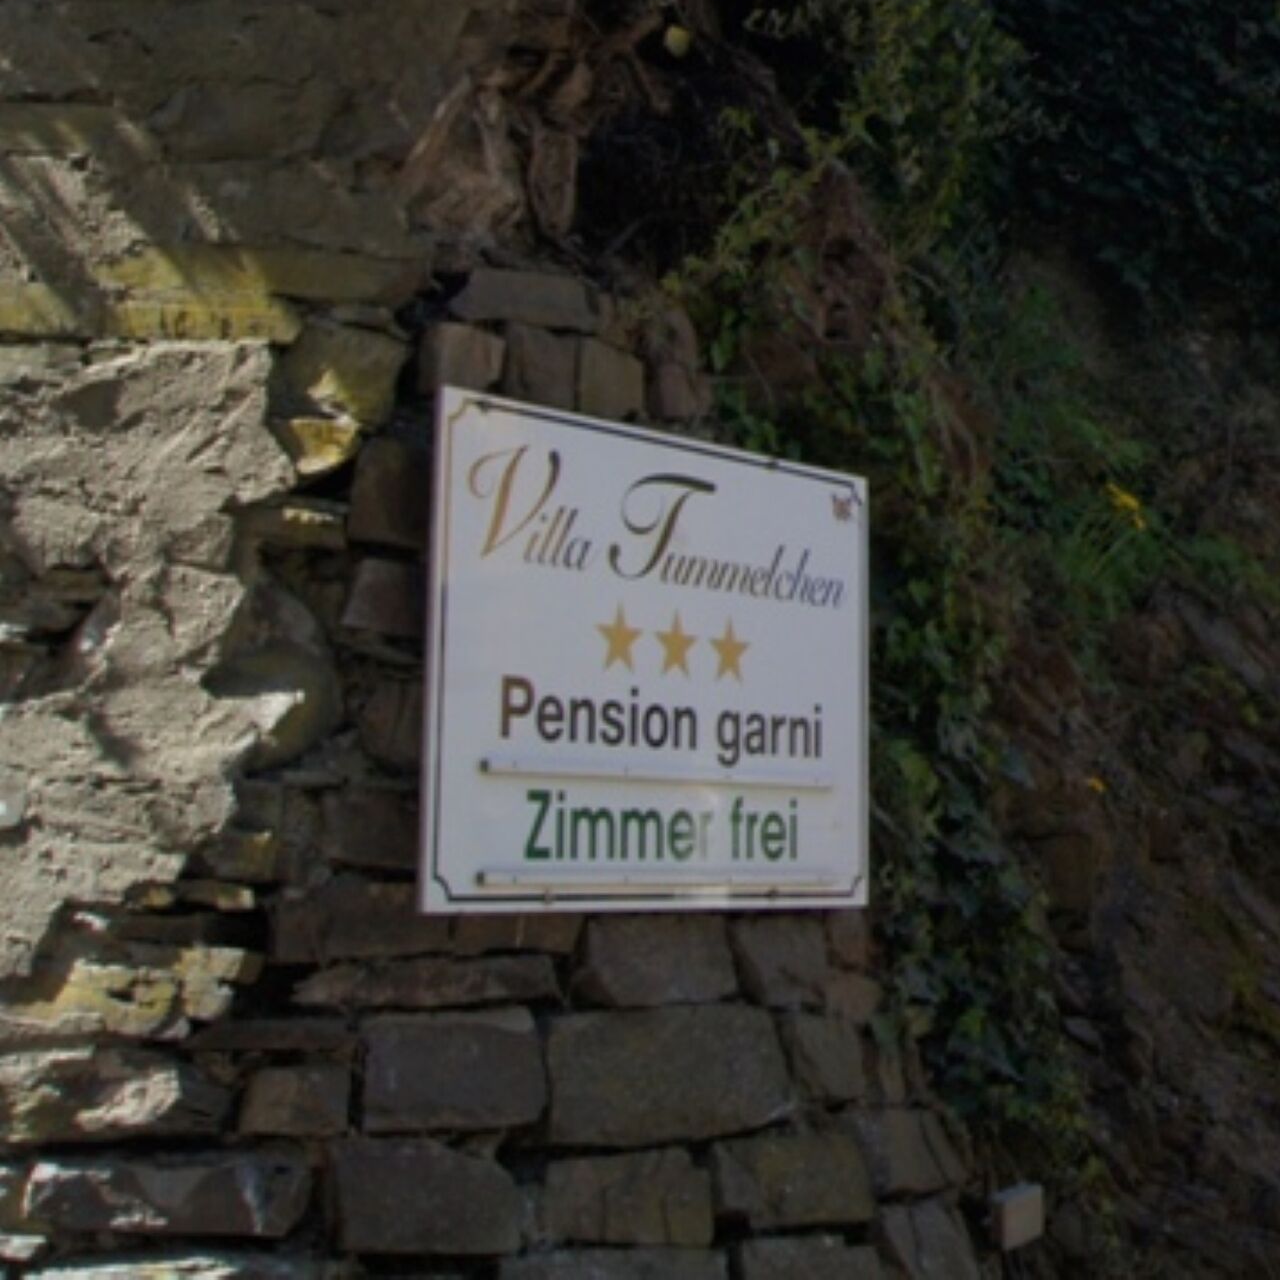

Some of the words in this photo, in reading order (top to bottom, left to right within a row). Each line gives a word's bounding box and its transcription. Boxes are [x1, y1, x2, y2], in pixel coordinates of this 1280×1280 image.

[467, 443, 593, 572] Villa
[608, 472, 846, 609] Tummelchen
[500, 674, 698, 753] Pension
[716, 705, 824, 767] garni
[523, 788, 714, 863] Zimmer
[731, 797, 798, 861] frei
